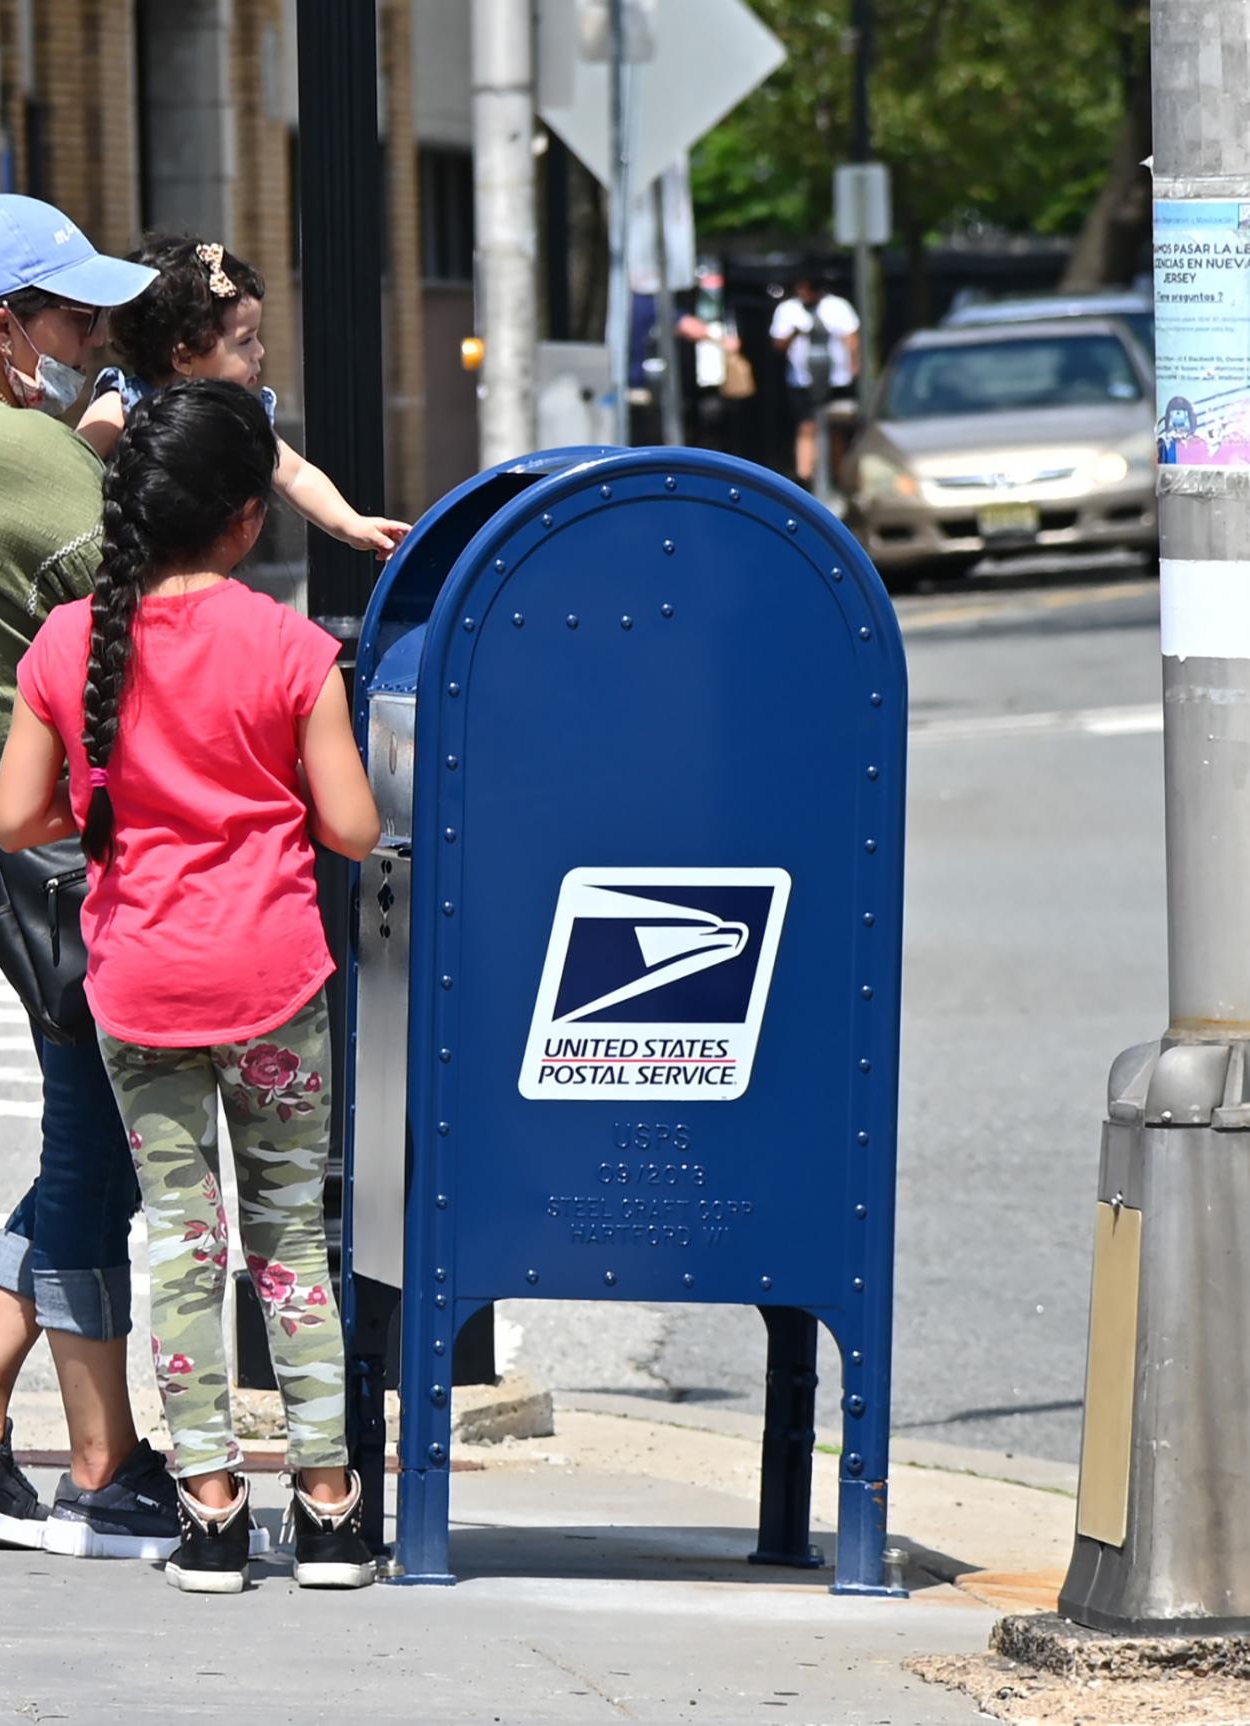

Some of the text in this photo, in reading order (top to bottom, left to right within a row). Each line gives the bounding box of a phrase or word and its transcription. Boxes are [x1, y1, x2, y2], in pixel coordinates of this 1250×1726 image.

[1173, 243, 1211, 255] PASAR
[1214, 243, 1232, 255] LA
[1185, 258, 1203, 270] EN
[1162, 272, 1197, 284] JERSEY
[544, 1038, 730, 1058] UNITED STATES
[538, 1065, 737, 1085] POSTAL SERVICE
[612, 1121, 690, 1151] USPS
[546, 1195, 614, 1218] STEEL
